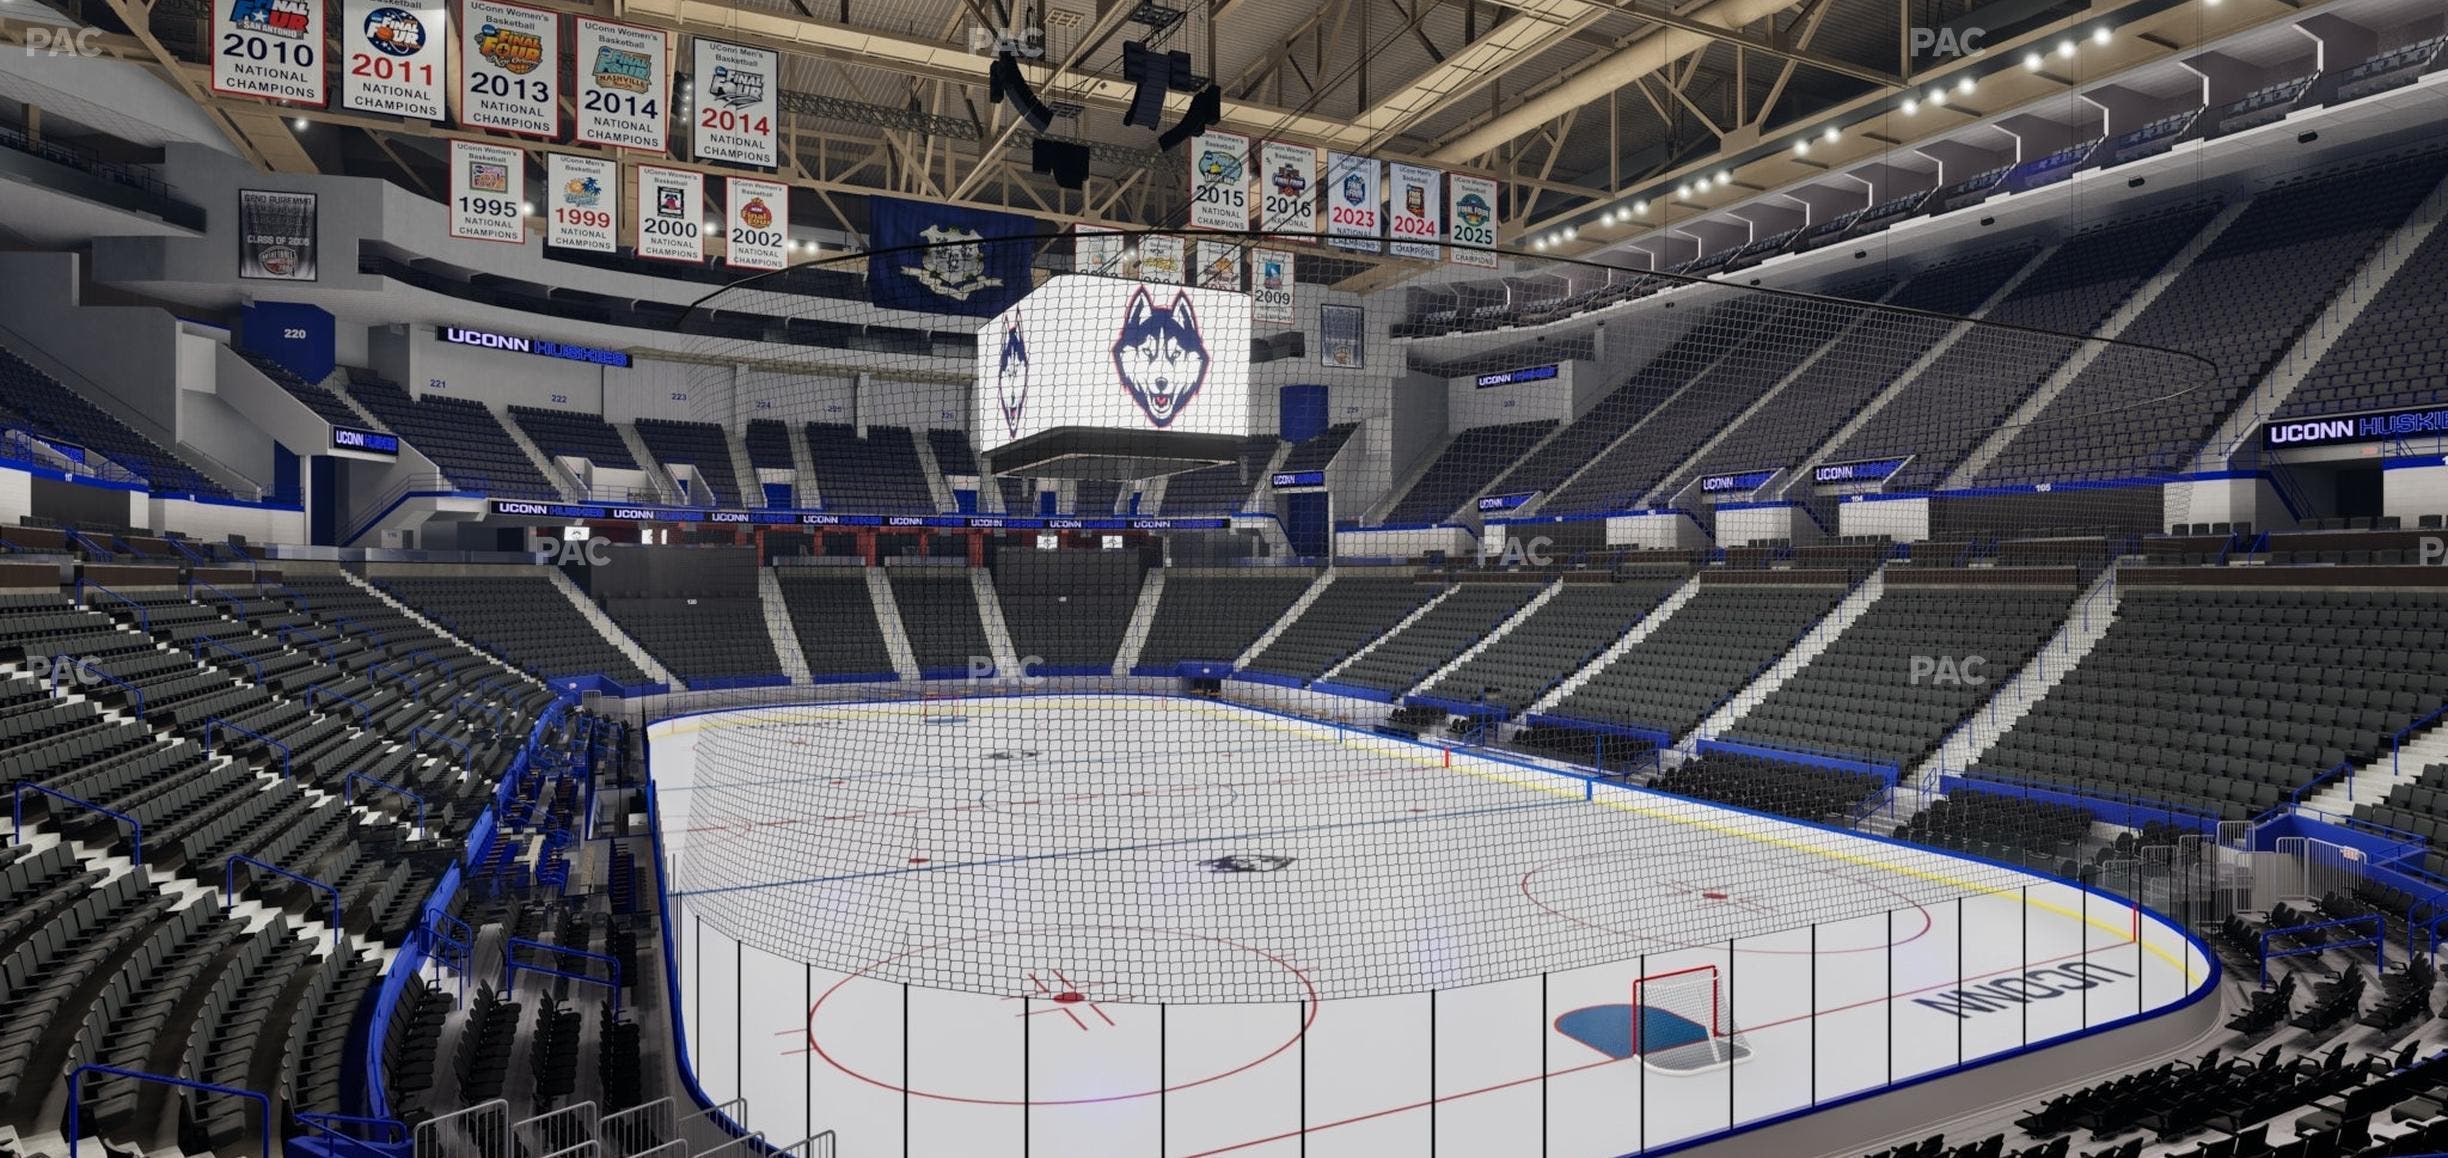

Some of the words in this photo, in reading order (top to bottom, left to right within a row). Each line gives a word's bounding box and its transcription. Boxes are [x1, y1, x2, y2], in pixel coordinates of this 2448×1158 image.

[486, 15, 535, 30] Basketball
[223, 33, 314, 67] 2010
[599, 35, 645, 49] Basketball
[715, 54, 758, 67] Basketball
[235, 64, 308, 82] NATIONAL
[352, 54, 432, 86] 2011
[227, 78, 315, 98] CHAMPIONS
[363, 83, 430, 101] NATIONAL
[471, 72, 549, 103] 2013
[355, 96, 437, 116] CHAMPIONS
[481, 100, 544, 117] NATIONAL
[584, 90, 658, 119] 2014
[473, 113, 550, 132] CHAMPIONS
[594, 117, 653, 133] NATIONAL
[702, 108, 770, 136] 2014
[587, 129, 659, 147] CHAMPIONS
[710, 134, 766, 149] NATIONAL
[704, 146, 770, 162] CHAMPIONS
[1196, 185, 1244, 207] 2015
[459, 196, 517, 218] 1995
[1202, 207, 1241, 218] NATIONAL
[1266, 195, 1311, 217] 2016
[465, 217, 513, 229] NATIONAL
[555, 207, 610, 228] 1999
[1197, 217, 1245, 229] CHAMPIONS
[1333, 206, 1375, 227] 2023
[459, 227, 518, 240] CHAMPIONS
[560, 228, 606, 239] NATIONAL
[644, 218, 697, 238] 2000
[1394, 215, 1435, 237] 2024
[247, 235, 274, 244] CLASS
[276, 236, 287, 245] OF
[732, 228, 782, 247] 2002
[1454, 225, 1493, 245] 2025
[555, 238, 610, 250] CHAMPIONS
[651, 238, 694, 249] NATIONAL
[646, 247, 698, 259] CHAMPIONS
[738, 247, 779, 258] NATIONAL
[734, 256, 783, 268] CHAMPIONS
[1255, 289, 1290, 305] 2009
[284, 328, 306, 339] 220
[447, 327, 529, 352] UCONN
[534, 339, 627, 367] HUSKIES
[430, 378, 446, 389] 221
[1479, 374, 1511, 386] UCONN
[336, 430, 364, 447] UCONN
[2271, 420, 2354, 443] UCONN
[1816, 466, 1853, 480] UCONN
[1703, 477, 1733, 490] UCONN
[500, 502, 547, 514] UCONN
[613, 509, 653, 519] UCONN
[712, 513, 748, 522] UCONN
[803, 515, 838, 524] UCONN
[889, 517, 922, 525] UCONN
[971, 518, 1002, 527] UCONN
[1911, 961, 2136, 1019] UCONN
